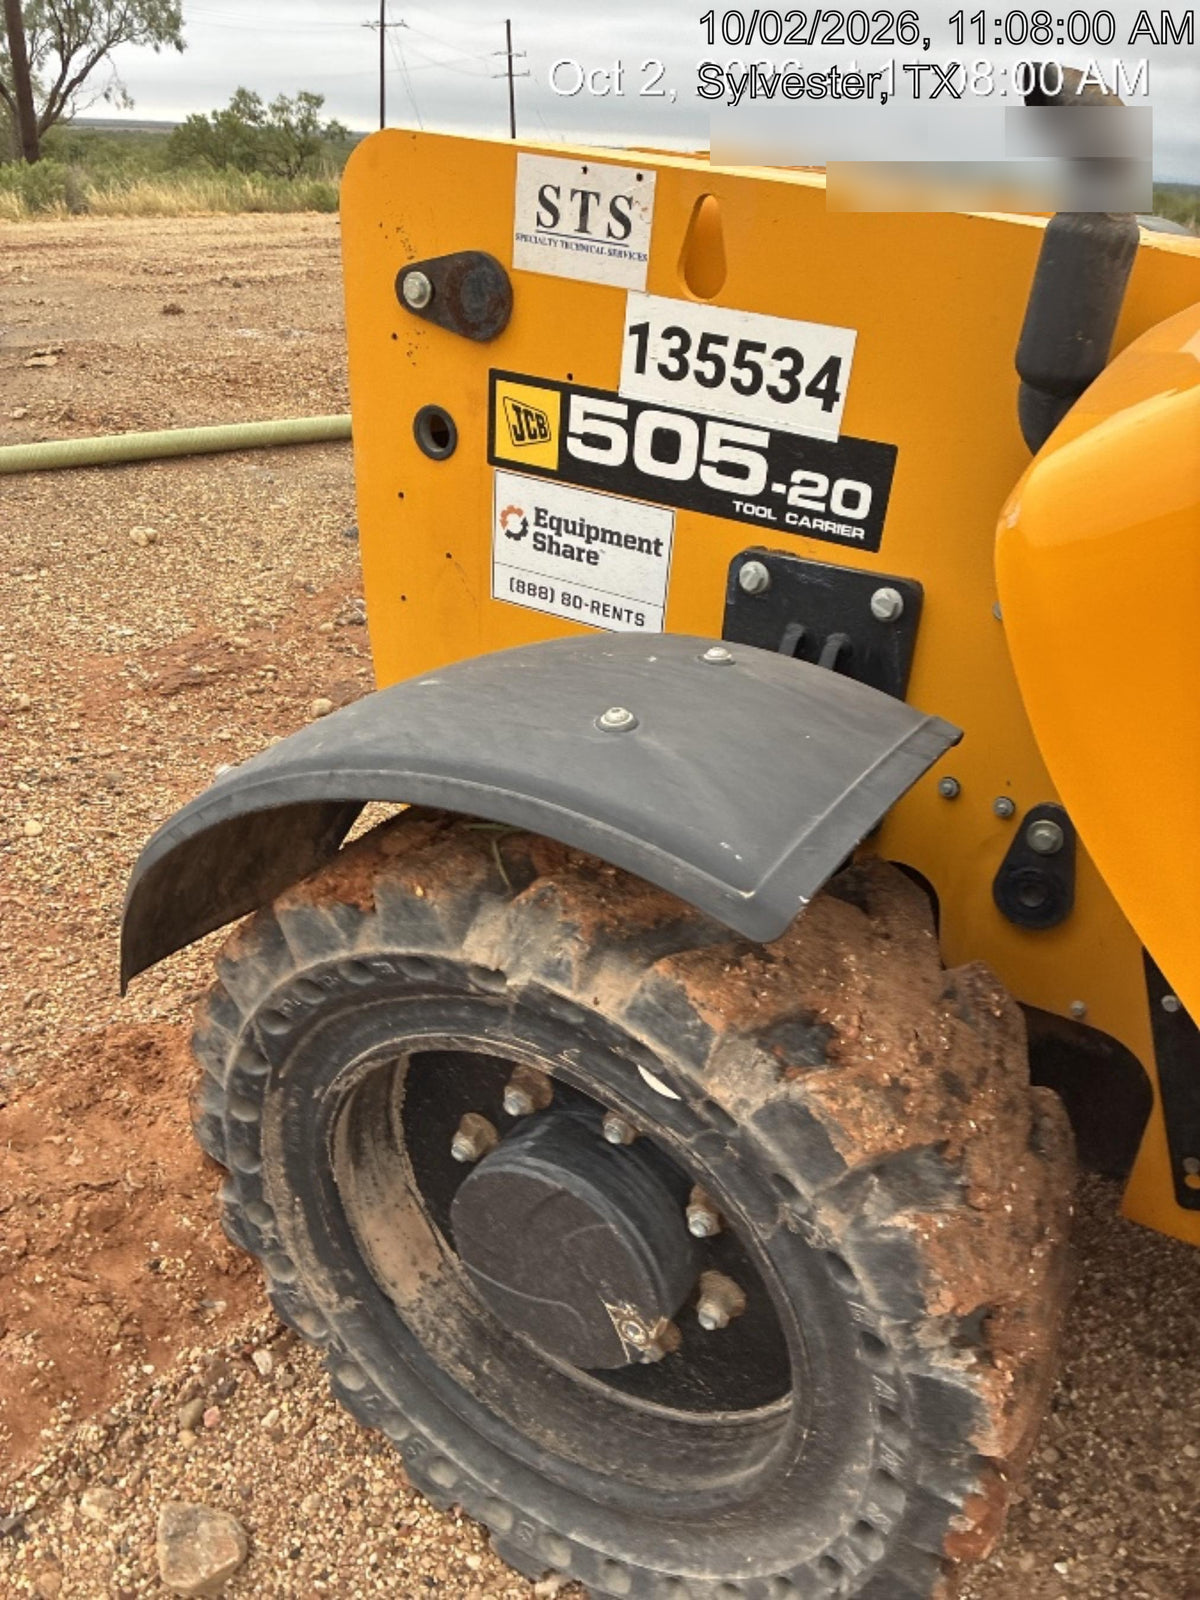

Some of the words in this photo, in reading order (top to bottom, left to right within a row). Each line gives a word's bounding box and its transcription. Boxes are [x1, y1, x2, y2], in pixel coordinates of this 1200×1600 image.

[535, 183, 634, 242] STS
[515, 232, 559, 248] SPECIALTY
[560, 239, 606, 256] TECHNICAL
[607, 247, 648, 262] SERVICES
[628, 320, 843, 414] 135534
[511, 405, 549, 442] JCB
[566, 393, 873, 521] 505-20
[533, 506, 664, 557] Equipment
[731, 500, 778, 521] TOOL
[785, 511, 866, 540] CARRIER
[532, 531, 600, 566] Share
[509, 576, 556, 604] (888)
[561, 591, 646, 628] 80-RENTS
